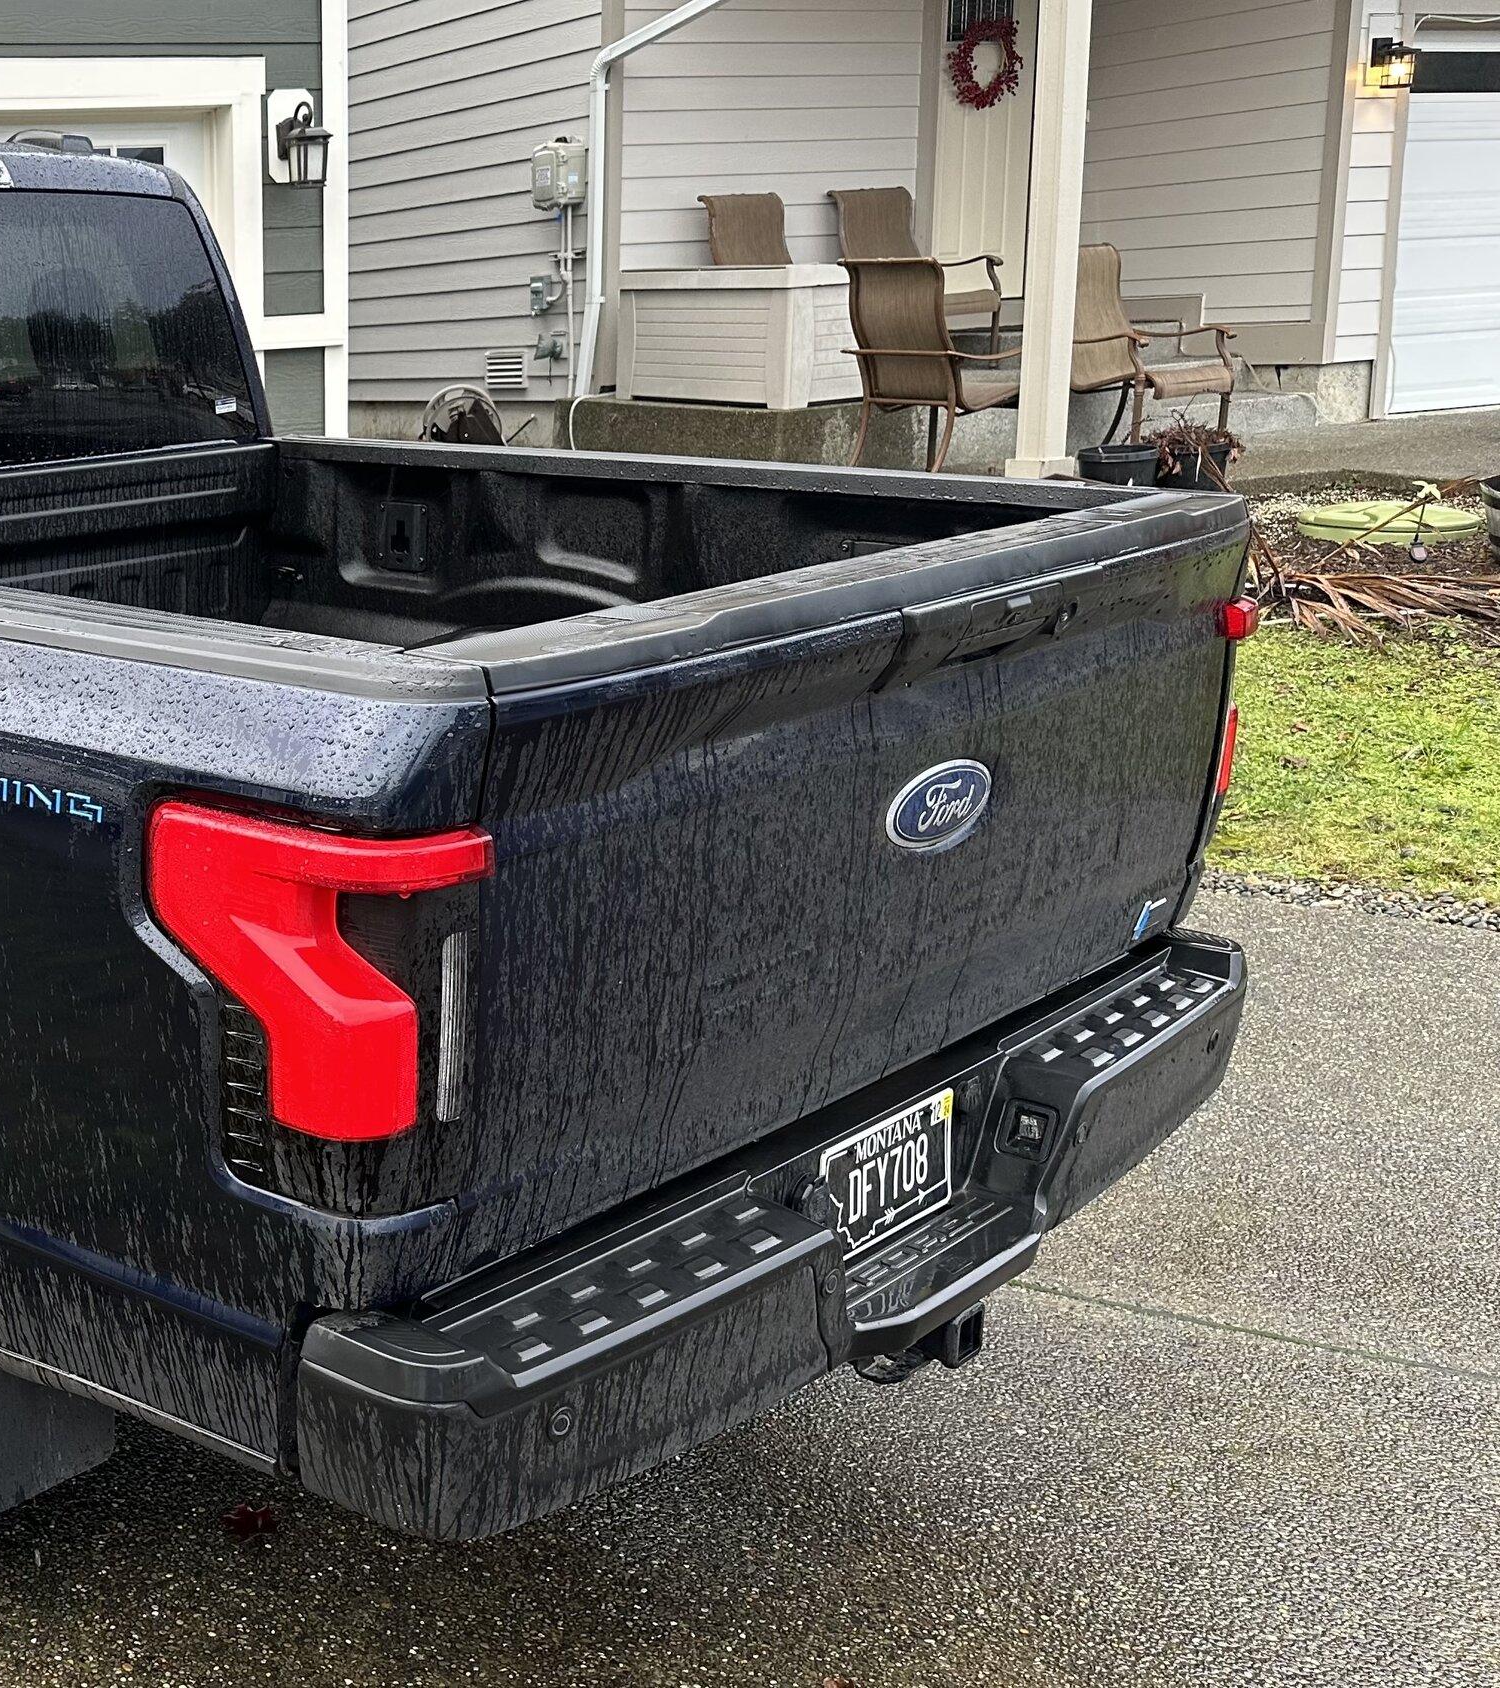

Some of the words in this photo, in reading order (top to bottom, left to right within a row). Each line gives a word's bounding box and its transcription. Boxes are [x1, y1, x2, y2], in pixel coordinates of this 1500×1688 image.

[917, 778, 975, 833] Ford
[854, 1111, 923, 1164] MONTANA
[848, 1132, 929, 1225] DFY708
